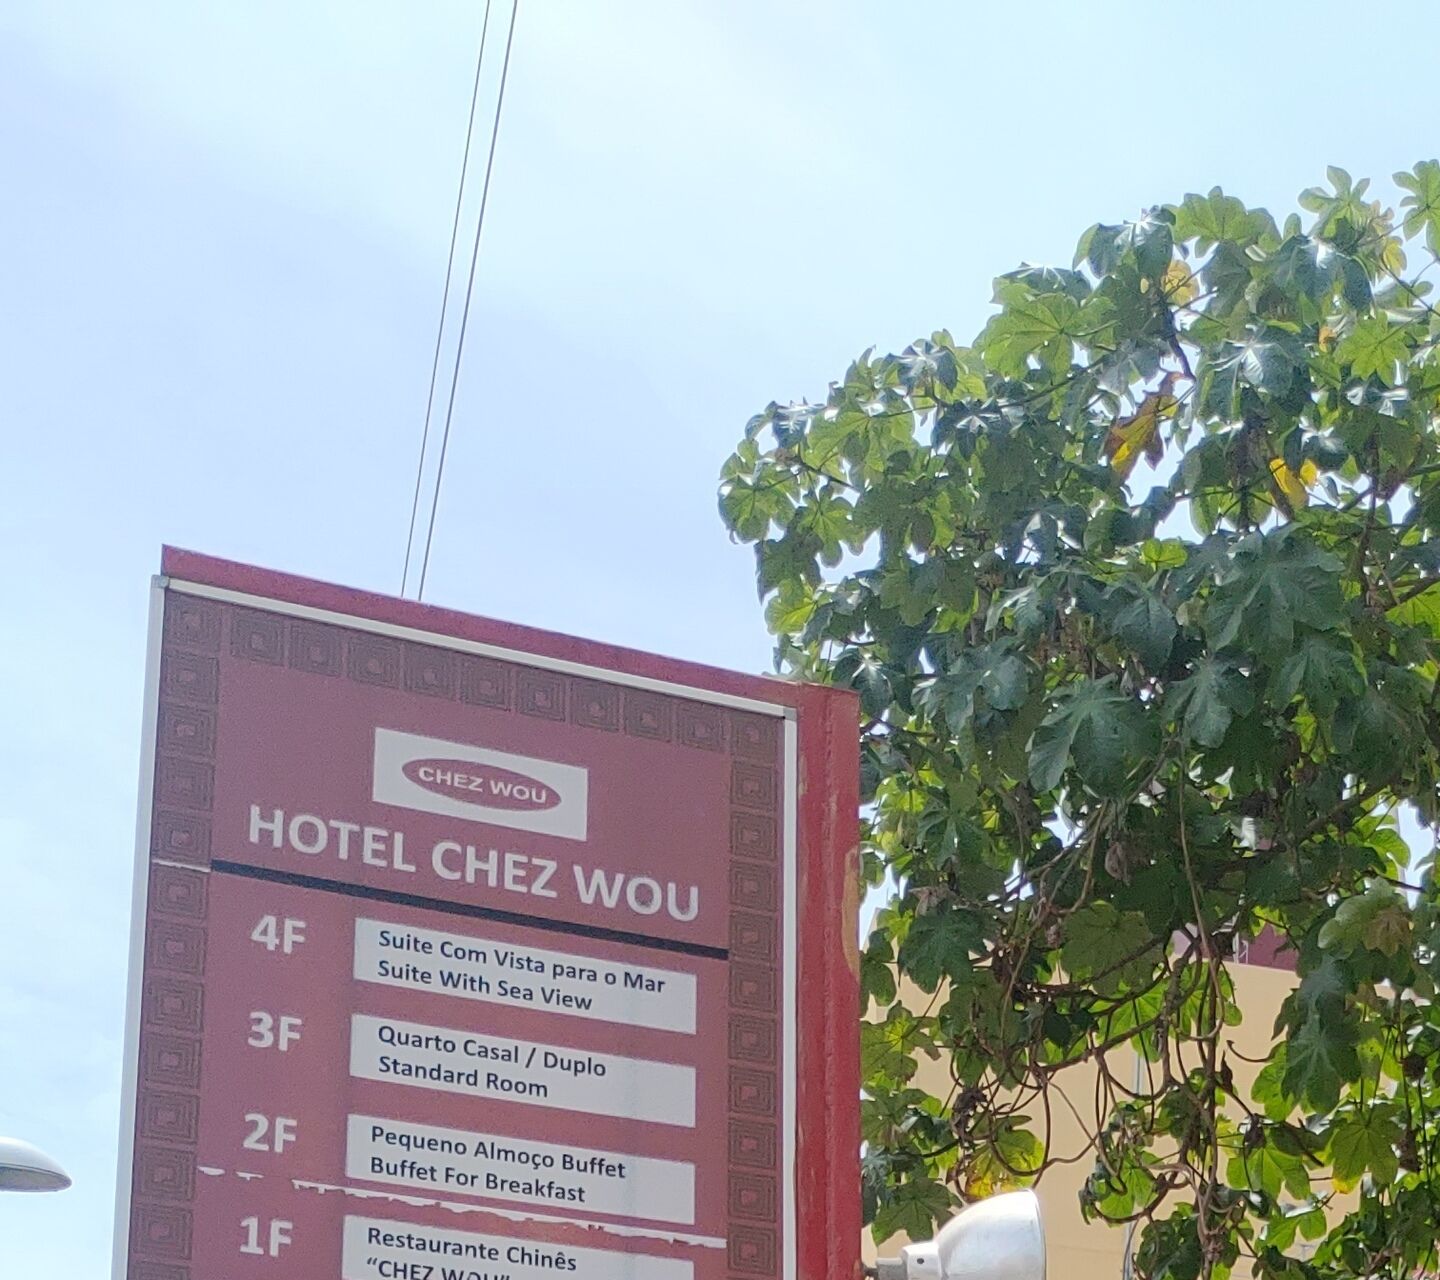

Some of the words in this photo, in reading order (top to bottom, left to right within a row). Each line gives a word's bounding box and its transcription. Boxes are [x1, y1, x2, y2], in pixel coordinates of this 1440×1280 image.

[418, 766, 483, 793] CHEZ
[490, 779, 547, 803] WOU
[249, 804, 416, 873] HOTEL
[431, 840, 558, 898] CHEZ
[573, 865, 700, 922] WOU
[250, 915, 306, 954] 4F
[377, 960, 432, 985] Suite
[439, 969, 491, 995] With
[497, 979, 534, 1002] Sea
[541, 986, 593, 1011] View
[378, 930, 433, 955] Suite
[440, 940, 487, 965] Com
[494, 949, 545, 974] Vista
[552, 961, 597, 984] para
[604, 971, 617, 986] o
[624, 972, 666, 994] Mar
[247, 1011, 302, 1052] 3F
[378, 1025, 456, 1055] Quarto
[463, 1038, 520, 1066] Casal
[525, 1046, 536, 1069] /
[543, 1052, 607, 1079] Duplo
[378, 1056, 478, 1088] Standard
[486, 1072, 549, 1099] Room
[242, 1112, 298, 1154] 2F
[371, 1125, 467, 1156] Pequeno
[474, 1141, 555, 1171] Almoço
[562, 1153, 627, 1180] Buffet
[370, 1156, 438, 1183] Buffet
[444, 1165, 478, 1189] For
[485, 1173, 586, 1204] Breakfast
[238, 1215, 293, 1258] 1F
[367, 1226, 499, 1262] Restaurante
[506, 1244, 577, 1273] Chinês
